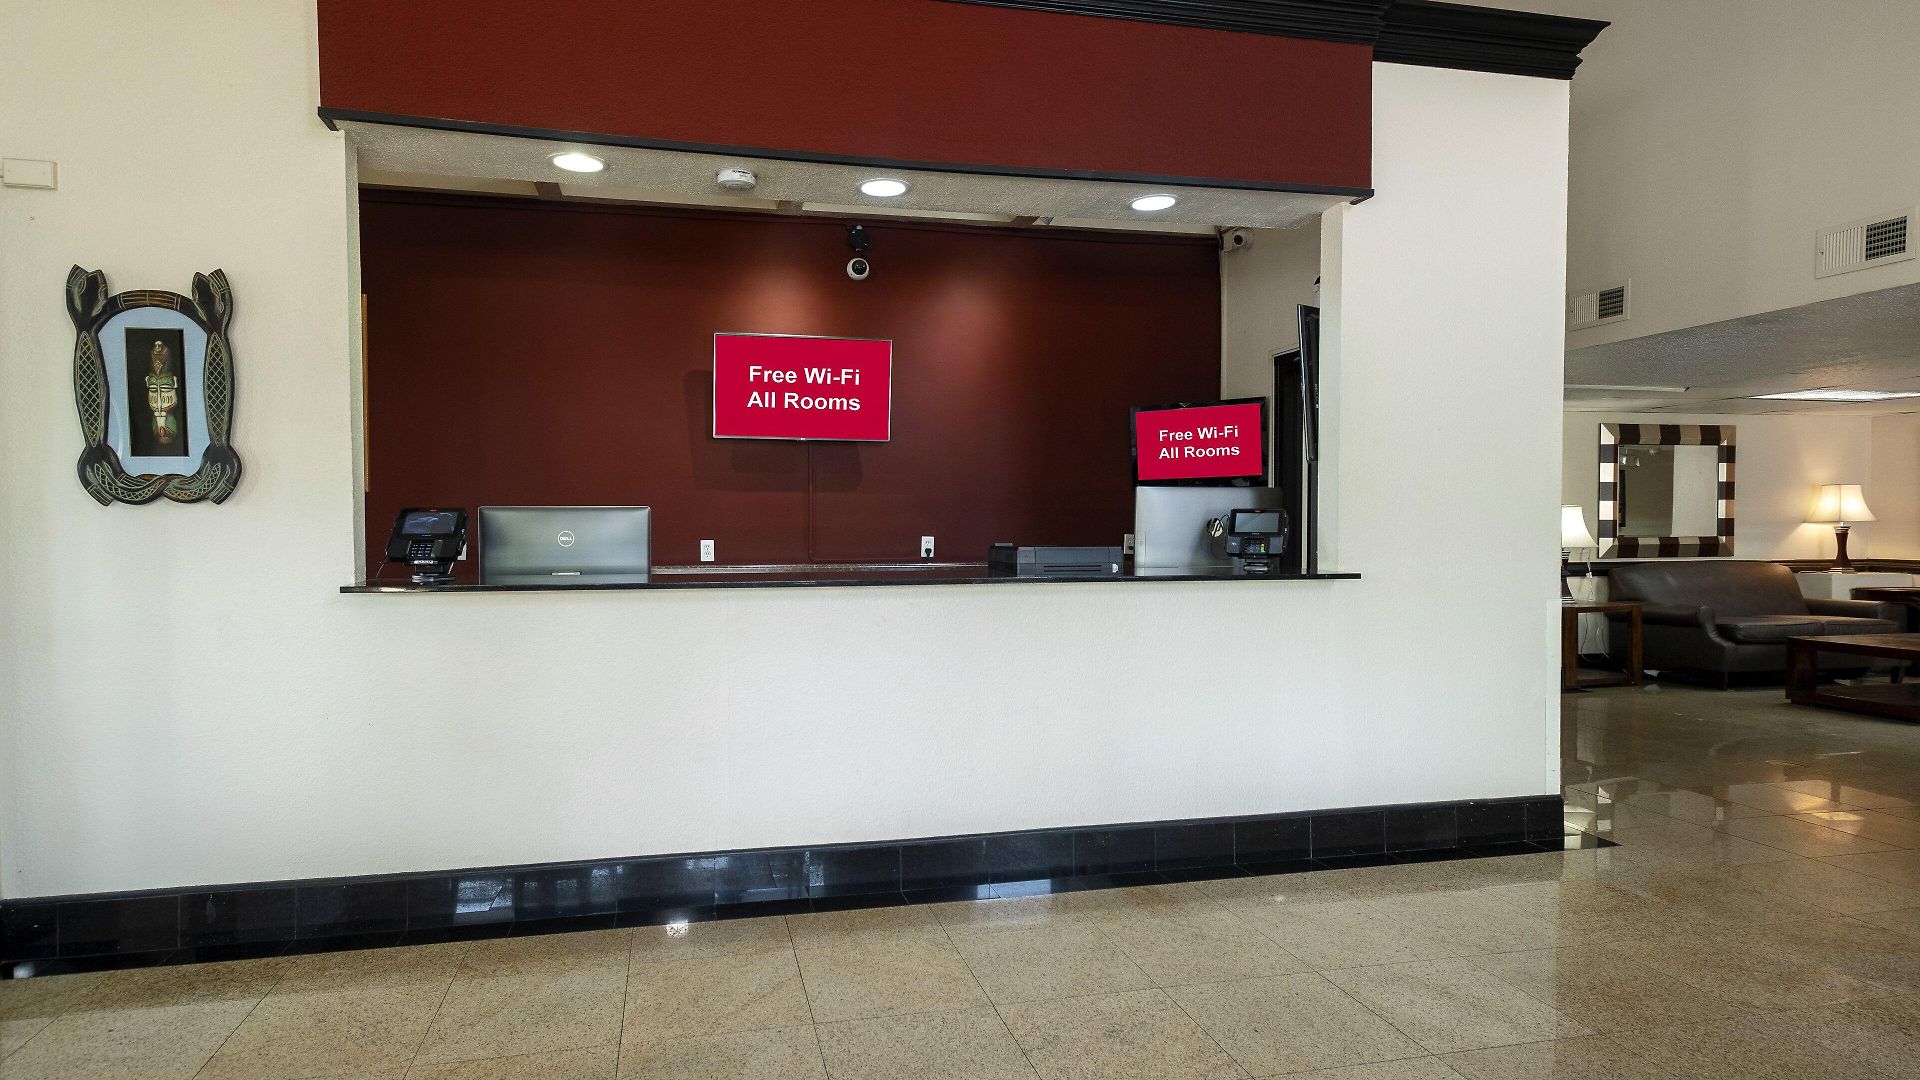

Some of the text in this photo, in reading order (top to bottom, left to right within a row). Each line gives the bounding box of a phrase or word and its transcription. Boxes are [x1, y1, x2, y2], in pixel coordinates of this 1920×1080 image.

[749, 365, 860, 386] Free Wi-Fi
[746, 391, 861, 411] All Rooms
[1158, 425, 1239, 442] Free Wi-Fi
[1158, 445, 1241, 460] All Rooms
